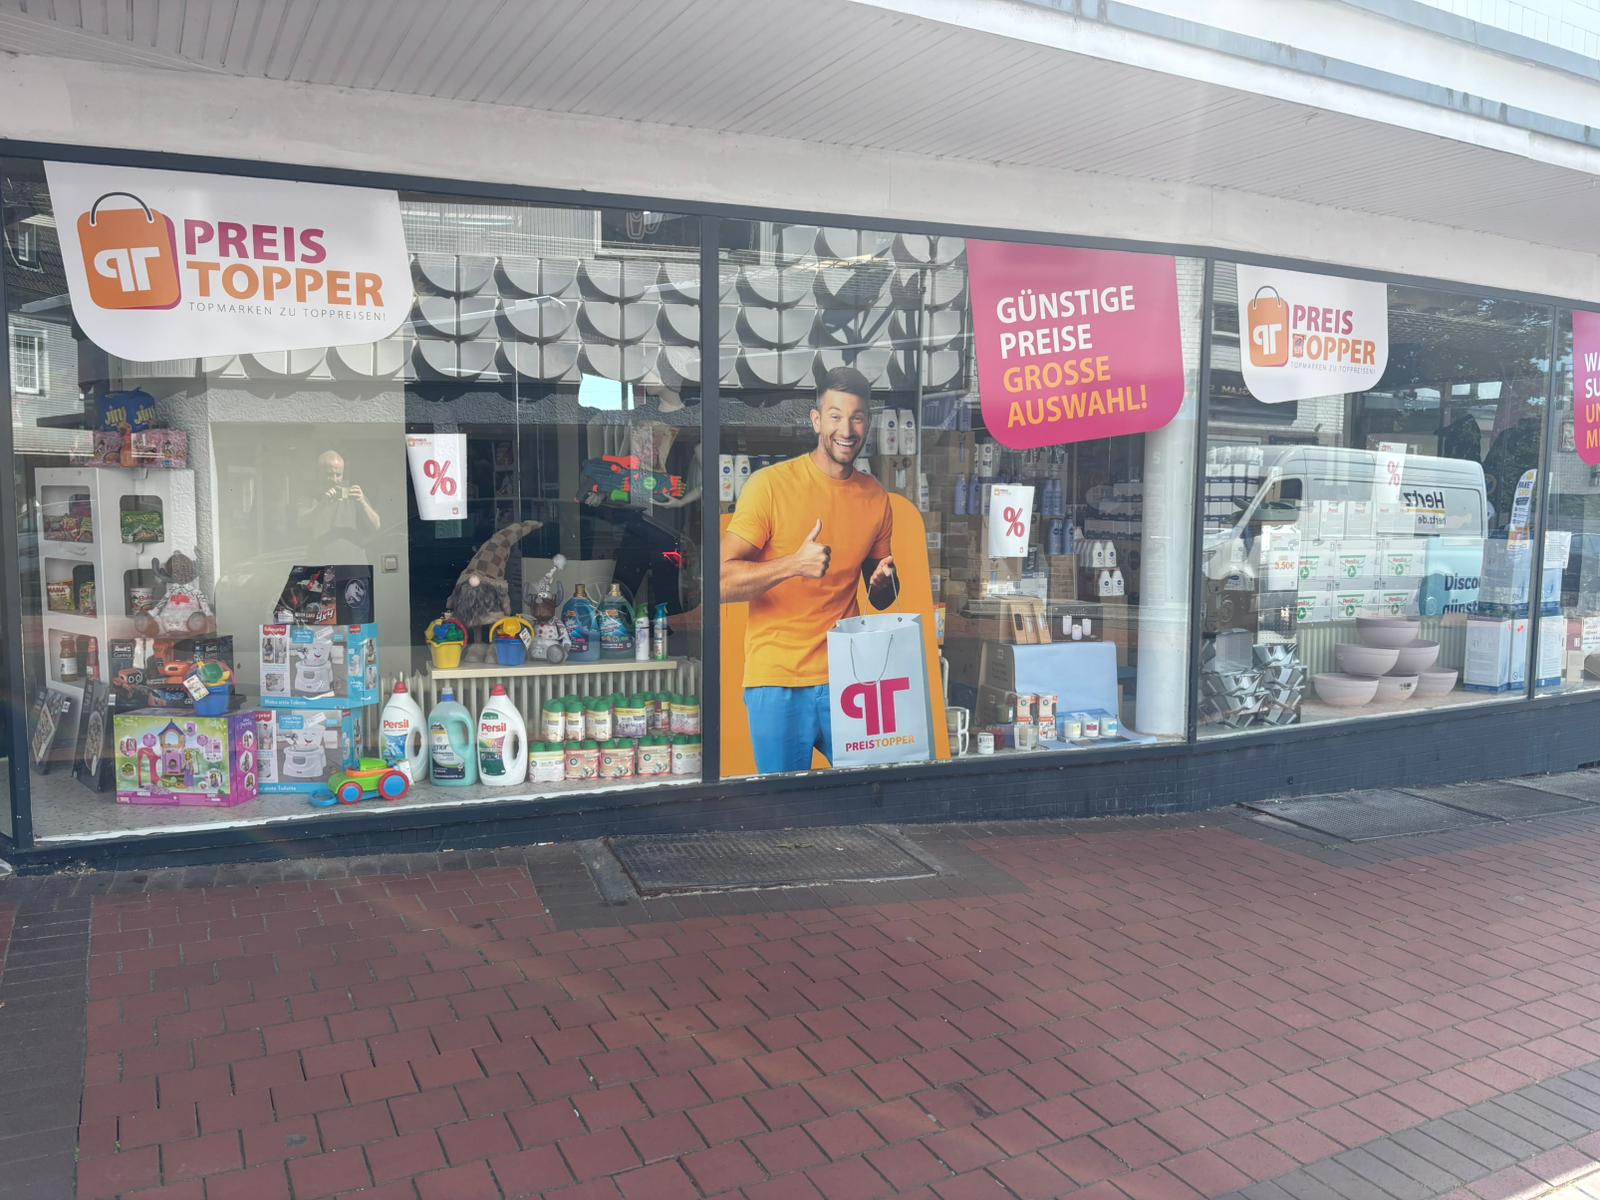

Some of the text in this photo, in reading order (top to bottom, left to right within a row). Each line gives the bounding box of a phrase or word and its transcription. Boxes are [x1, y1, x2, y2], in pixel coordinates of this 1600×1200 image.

[184, 219, 327, 264] PREIS
[186, 260, 384, 307] TOPPER
[188, 302, 387, 322] TOPMARKEN ZU TOPPREISEN!
[996, 285, 1136, 324] GÜNSTIGE
[1292, 304, 1354, 335] PREIS
[1000, 323, 1093, 360] PREISE
[1292, 333, 1376, 365] TOPPER
[1003, 355, 1112, 393] GROSSE
[1008, 384, 1148, 428] AUSWAHL!
[383, 719, 409, 729] Persil
[481, 722, 507, 732] Persil
[845, 736, 915, 752] PREISTOPPER
